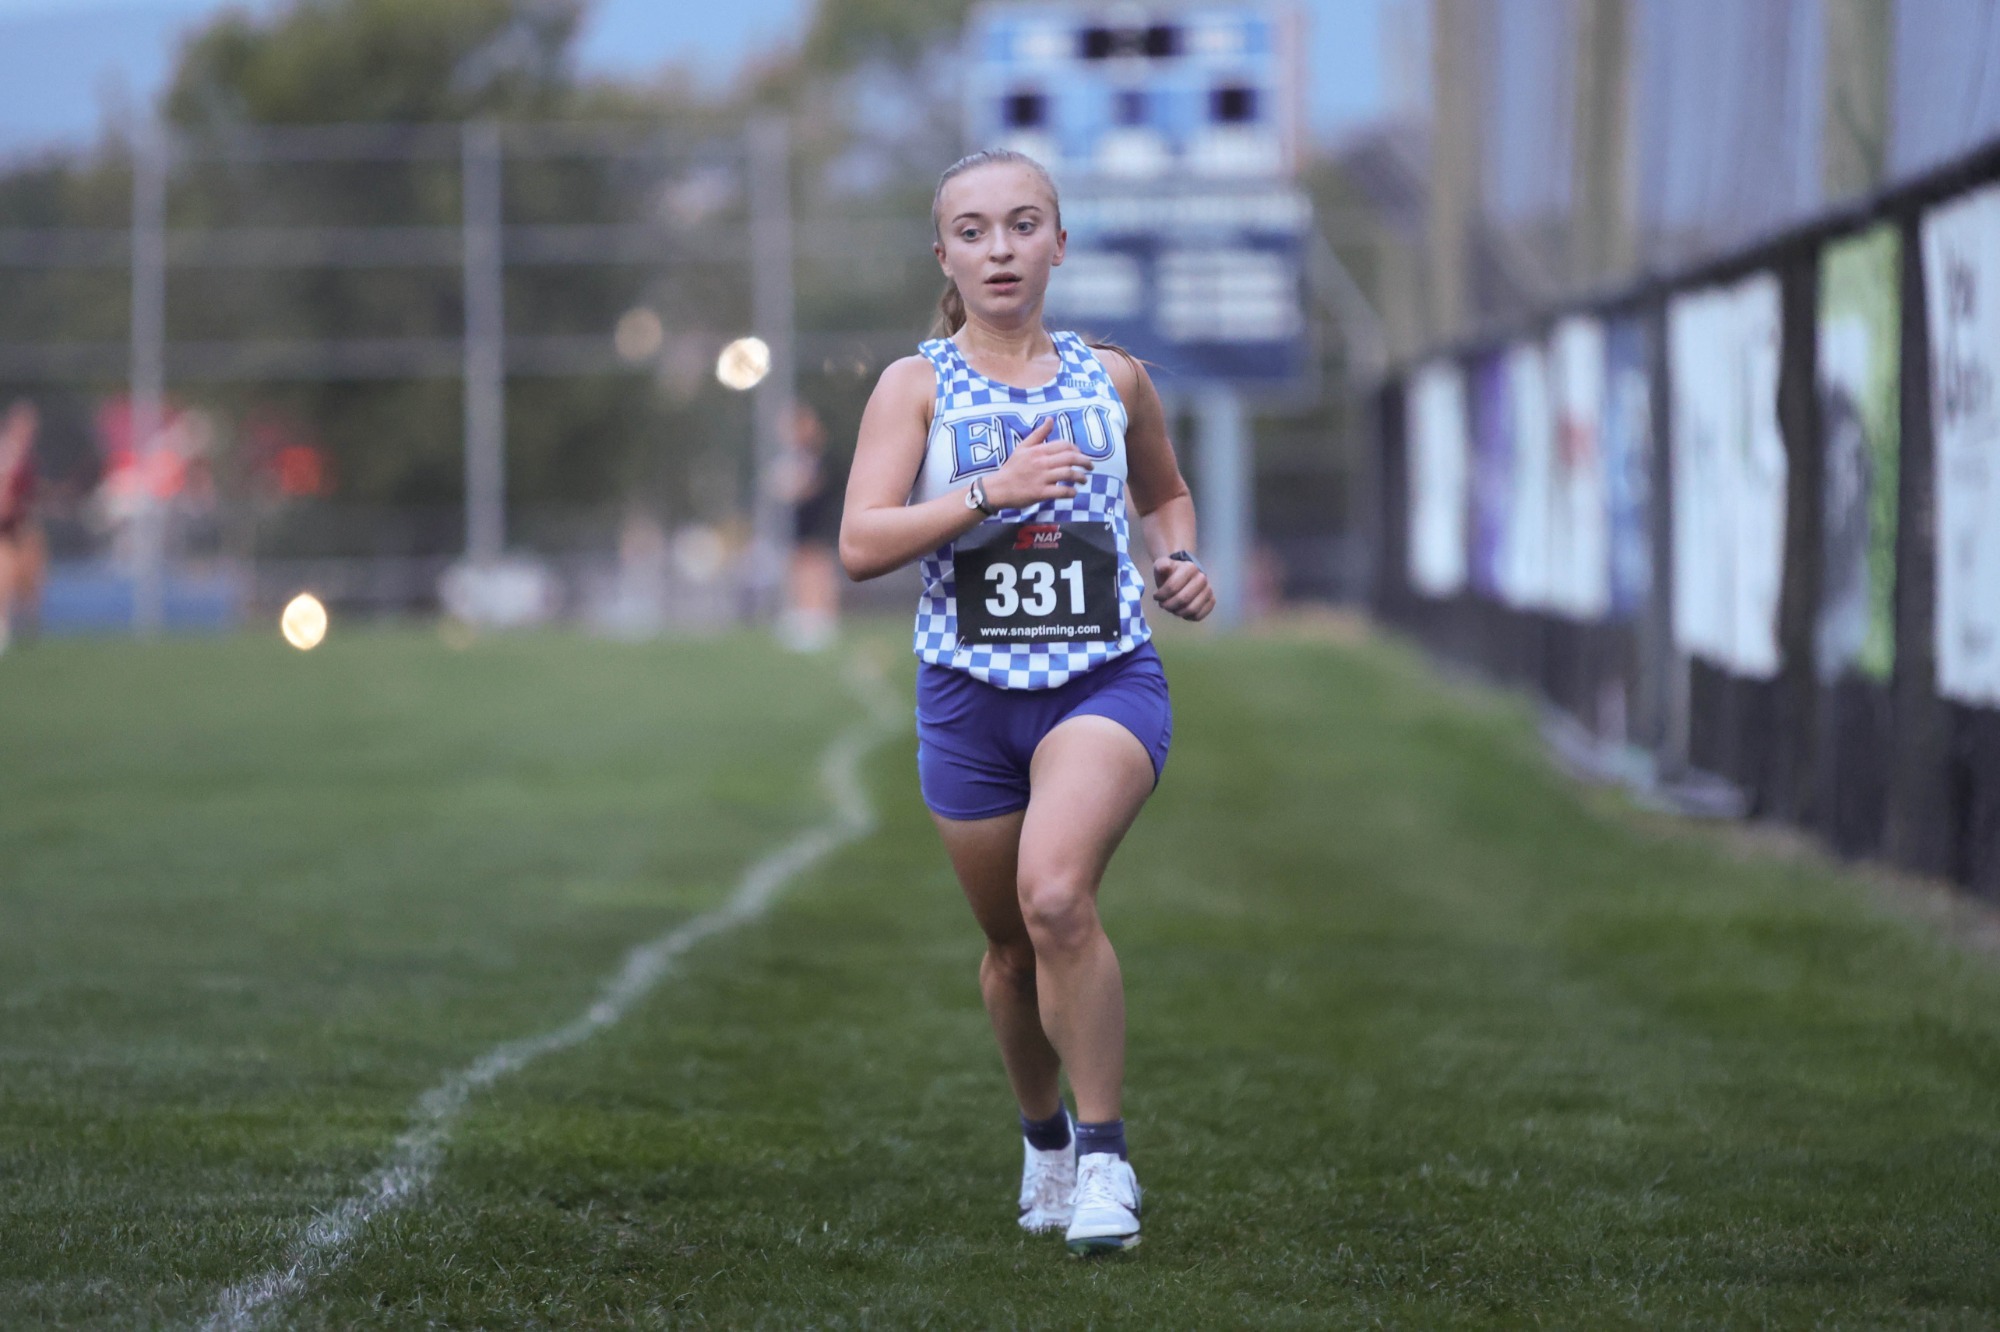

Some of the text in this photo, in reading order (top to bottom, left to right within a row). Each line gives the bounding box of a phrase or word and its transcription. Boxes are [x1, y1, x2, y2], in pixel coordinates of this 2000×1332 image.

[943, 404, 1115, 483] EMU
[1012, 524, 1062, 550] SNAP
[984, 560, 1085, 617] 331
[980, 624, 1101, 638] www.snaptiming.com
